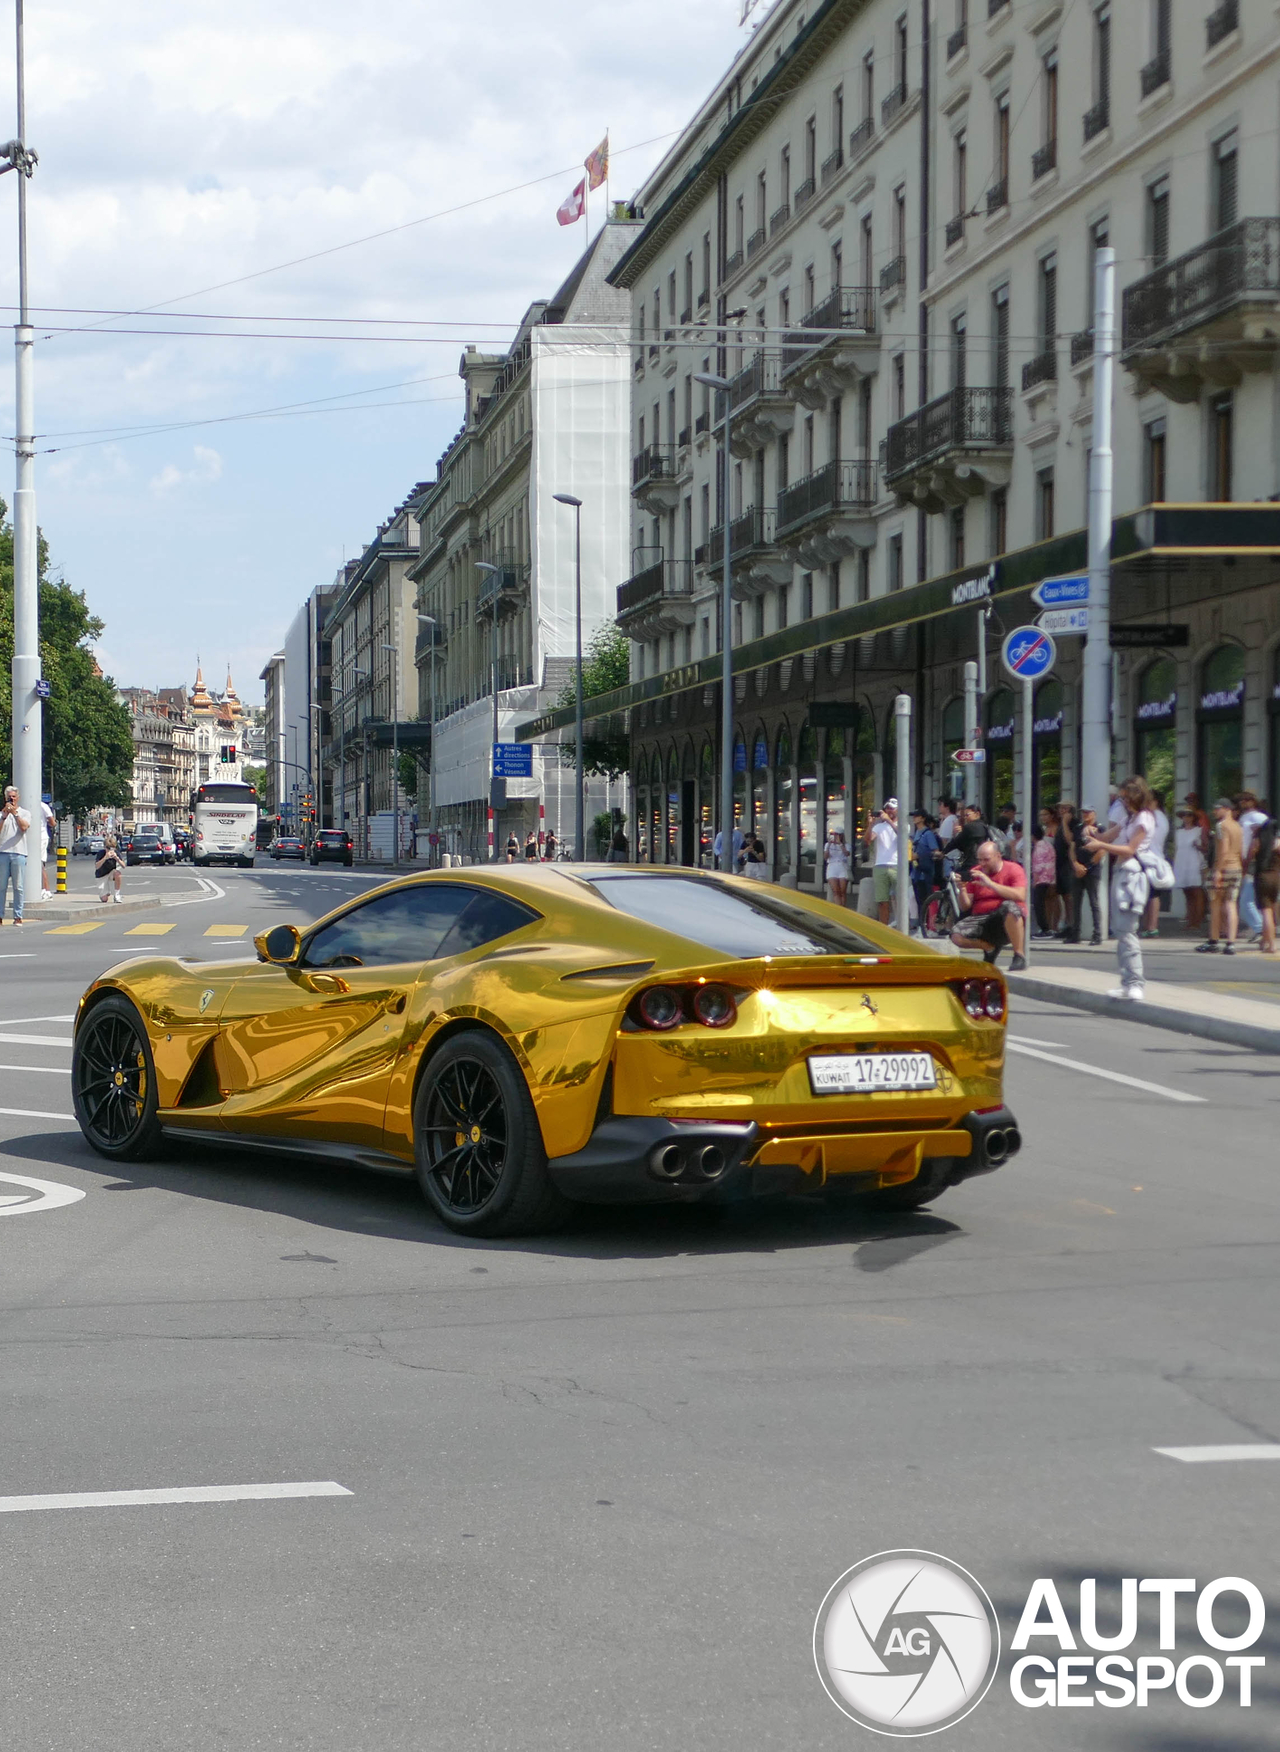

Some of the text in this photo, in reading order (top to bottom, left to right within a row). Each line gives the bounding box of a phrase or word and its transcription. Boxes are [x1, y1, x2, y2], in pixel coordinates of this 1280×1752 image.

[952, 574, 991, 604] MONTBLANC
[1044, 582, 1078, 598] Eaux-Vives
[1044, 610, 1069, 633] Hôpital
[1202, 690, 1240, 709] MONTBLANC
[1138, 701, 1171, 718] MONTBLANC
[816, 1072, 851, 1084] KUWAIT
